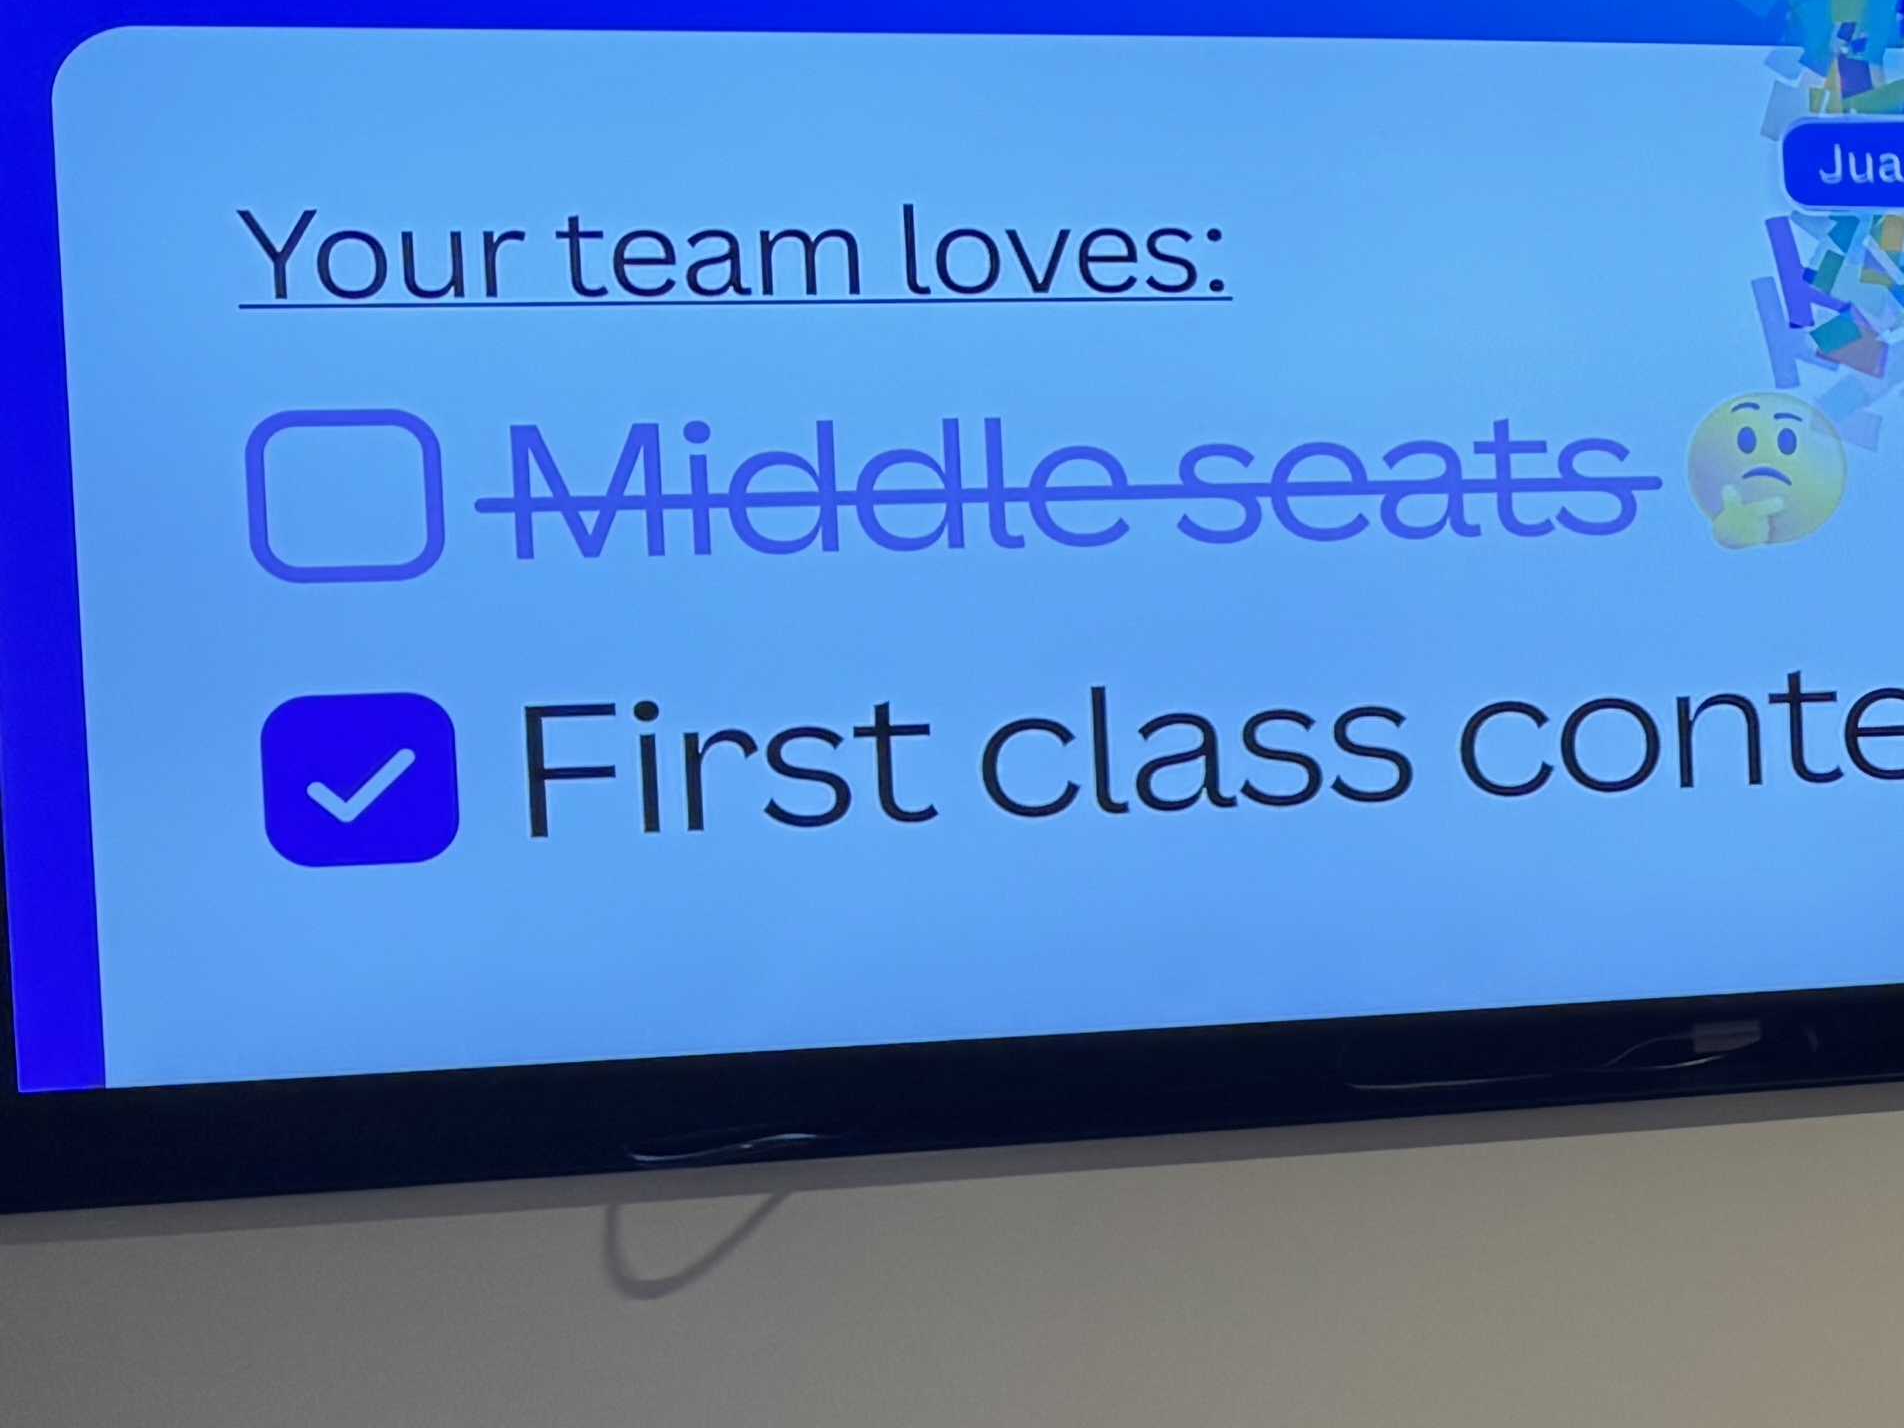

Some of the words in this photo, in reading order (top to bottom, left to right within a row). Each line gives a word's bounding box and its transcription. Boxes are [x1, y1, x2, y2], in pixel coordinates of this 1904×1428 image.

[237, 208, 526, 300] Your
[556, 214, 862, 296] team
[902, 203, 1227, 294] loves:
[506, 417, 1131, 560] Middle
[1175, 417, 1642, 544] seats
[524, 700, 939, 838] First
[981, 685, 1413, 818] class
